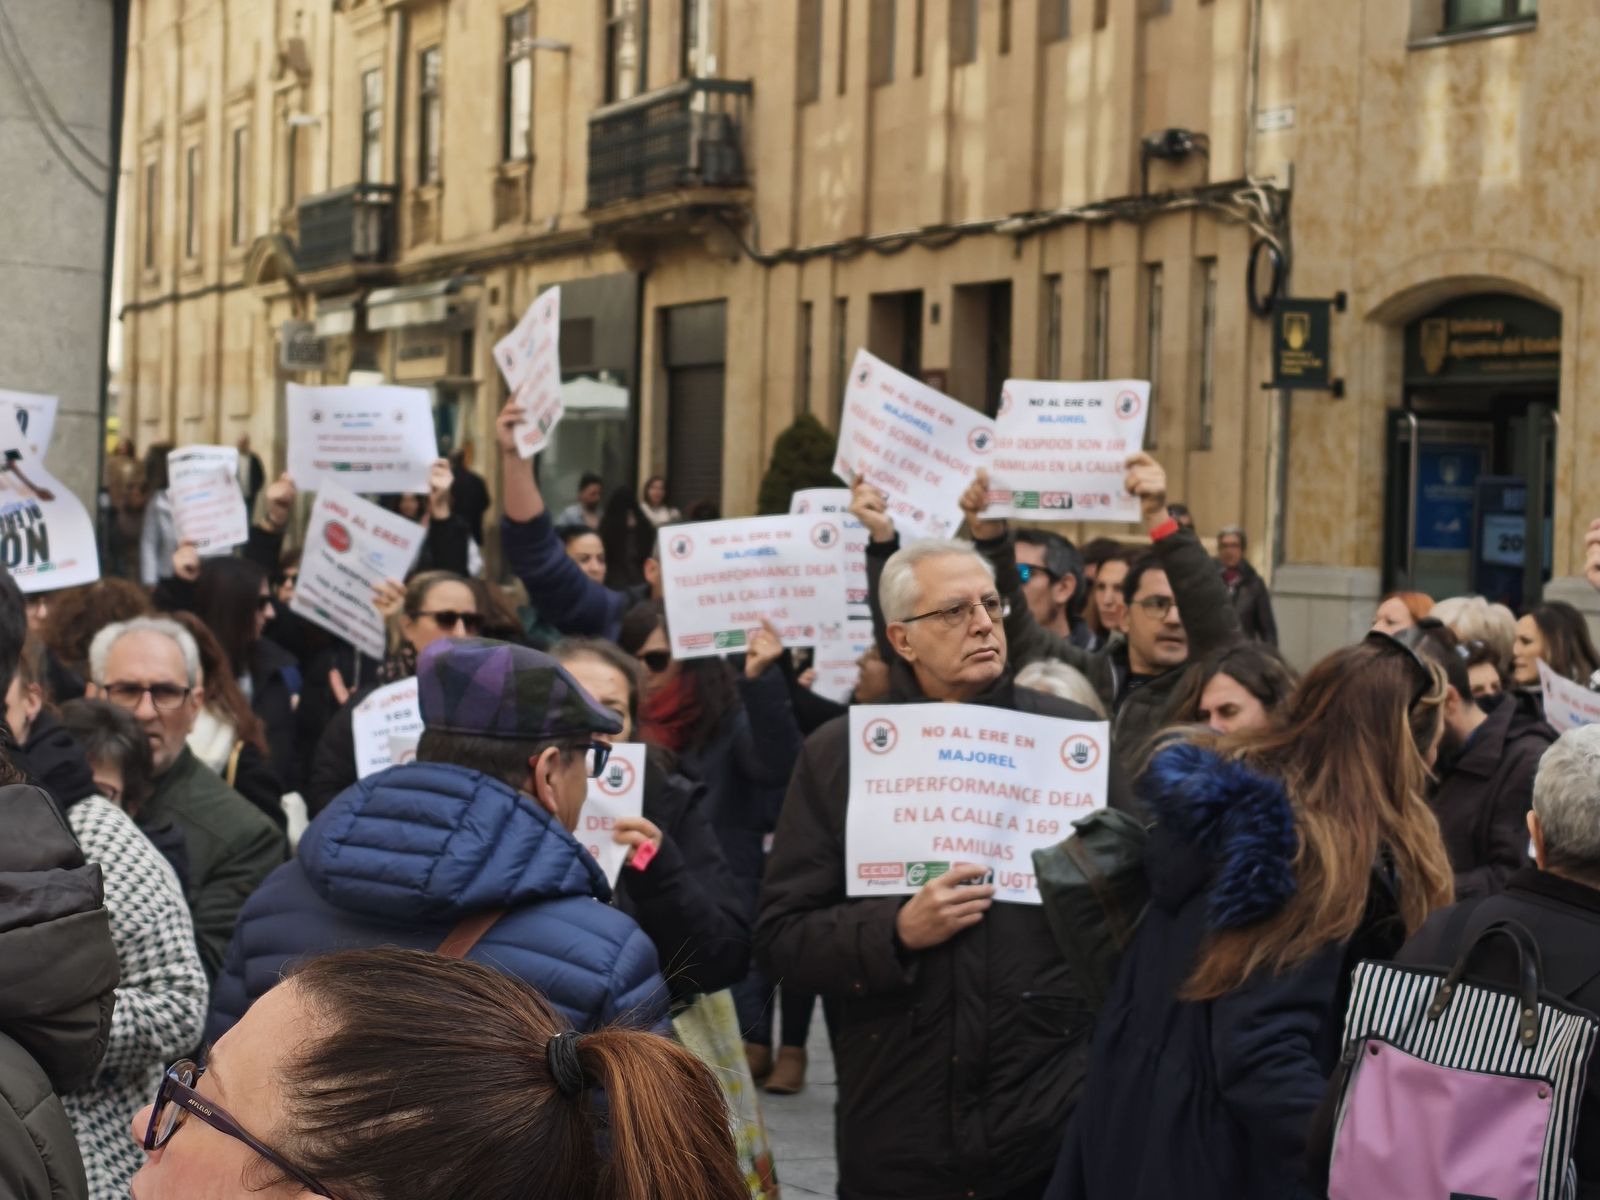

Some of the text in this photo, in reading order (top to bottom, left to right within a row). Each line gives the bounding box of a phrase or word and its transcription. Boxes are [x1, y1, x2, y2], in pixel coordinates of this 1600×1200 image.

[1029, 398, 1103, 407] NO AL ERE EN
[882, 402, 934, 436] MAJOREL
[1037, 415, 1087, 424] MAJOREL
[888, 426, 930, 455] SOBRA
[1016, 438, 1073, 450] DESPIDOS
[993, 459, 1123, 473] FAMILIAS EN LA CALLE
[1043, 493, 1071, 507] CGT
[674, 563, 838, 588] TELEPERFORMANCE DEJA
[697, 594, 716, 607] EN
[719, 592, 736, 605] LA
[738, 588, 775, 603] CALLE
[779, 587, 789, 598] A
[920, 726, 1036, 749] NO AL ERE EN
[937, 749, 1017, 769] MAJOREL
[865, 776, 1095, 807] TELEPERFORMANCE DEJA
[893, 806, 1059, 835] EN LA CALLE A 169
[932, 836, 1014, 861] FAMILIAS
[999, 871, 1034, 888] UGT
[188, 1099, 212, 1116] AFFLELOU
